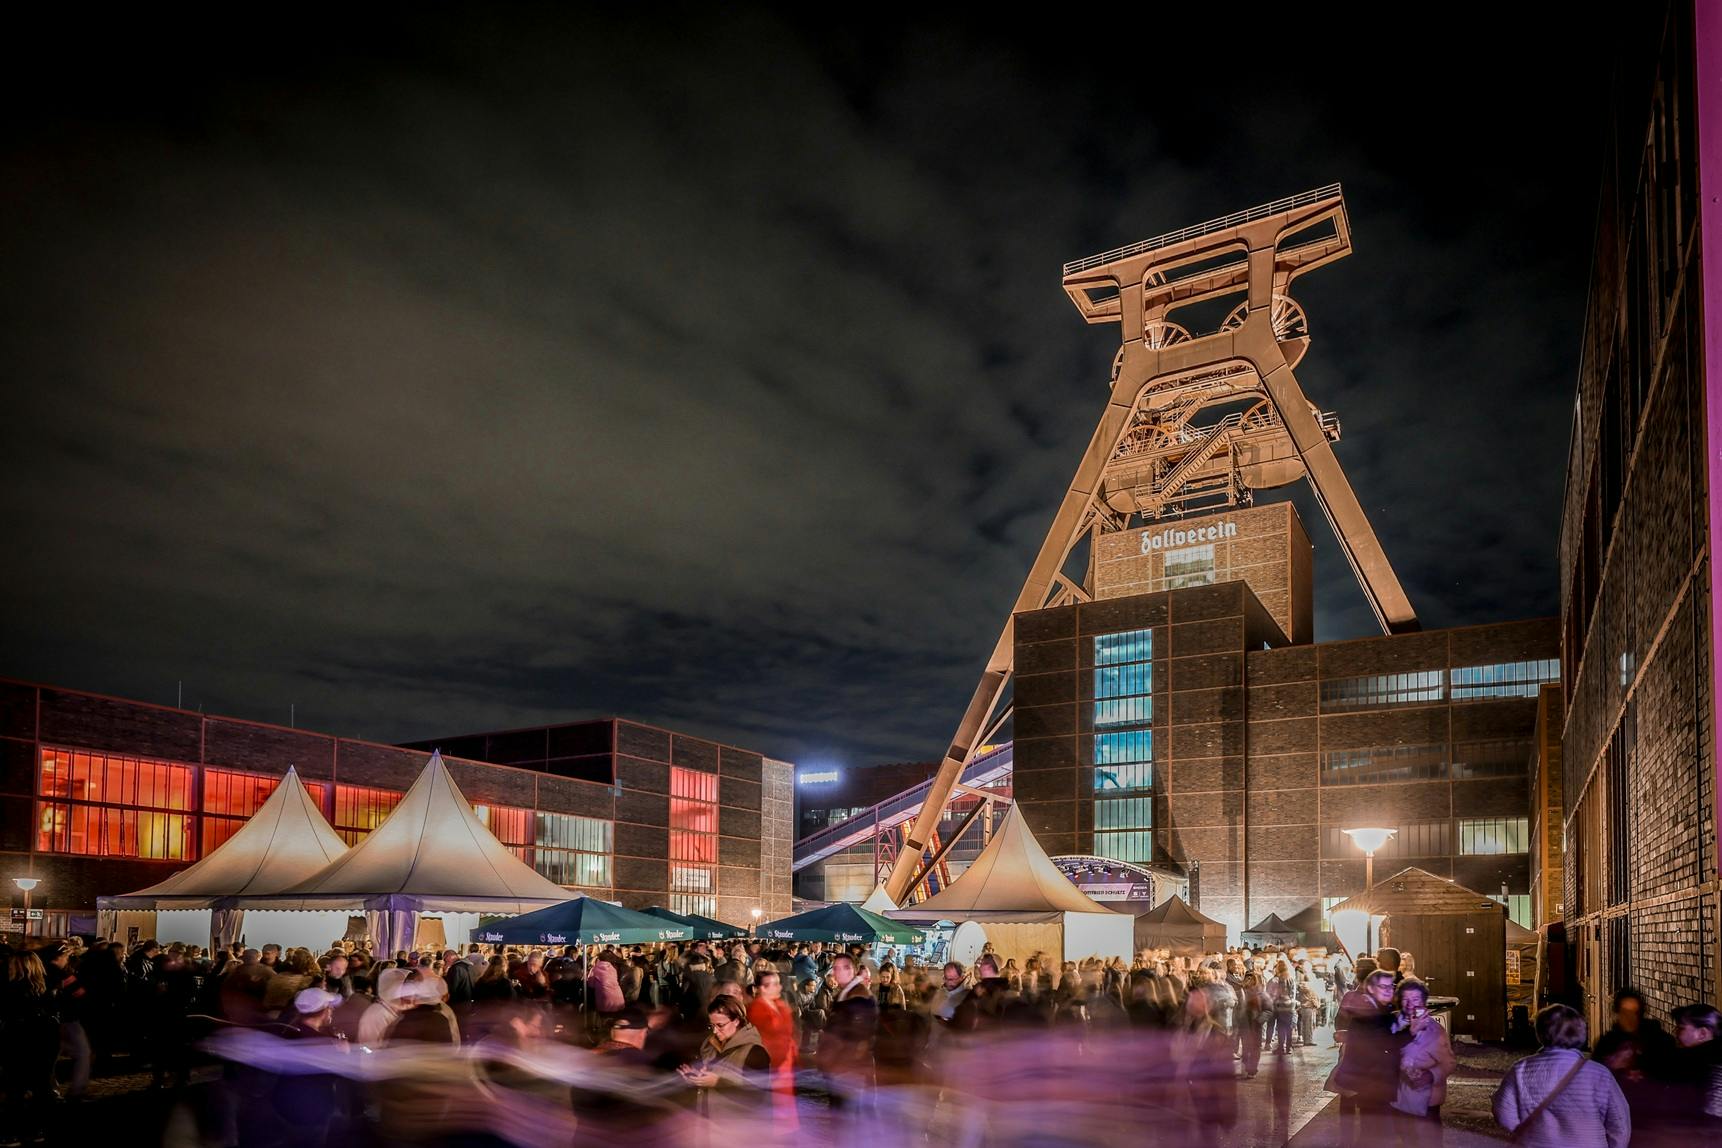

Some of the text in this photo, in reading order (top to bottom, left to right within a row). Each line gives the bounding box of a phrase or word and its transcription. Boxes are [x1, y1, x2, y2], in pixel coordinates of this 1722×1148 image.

[1141, 521, 1237, 554] Zollverein
[485, 932, 504, 942] Stauder
[774, 930, 794, 938] Stauder
[842, 932, 863, 942] Stauder
